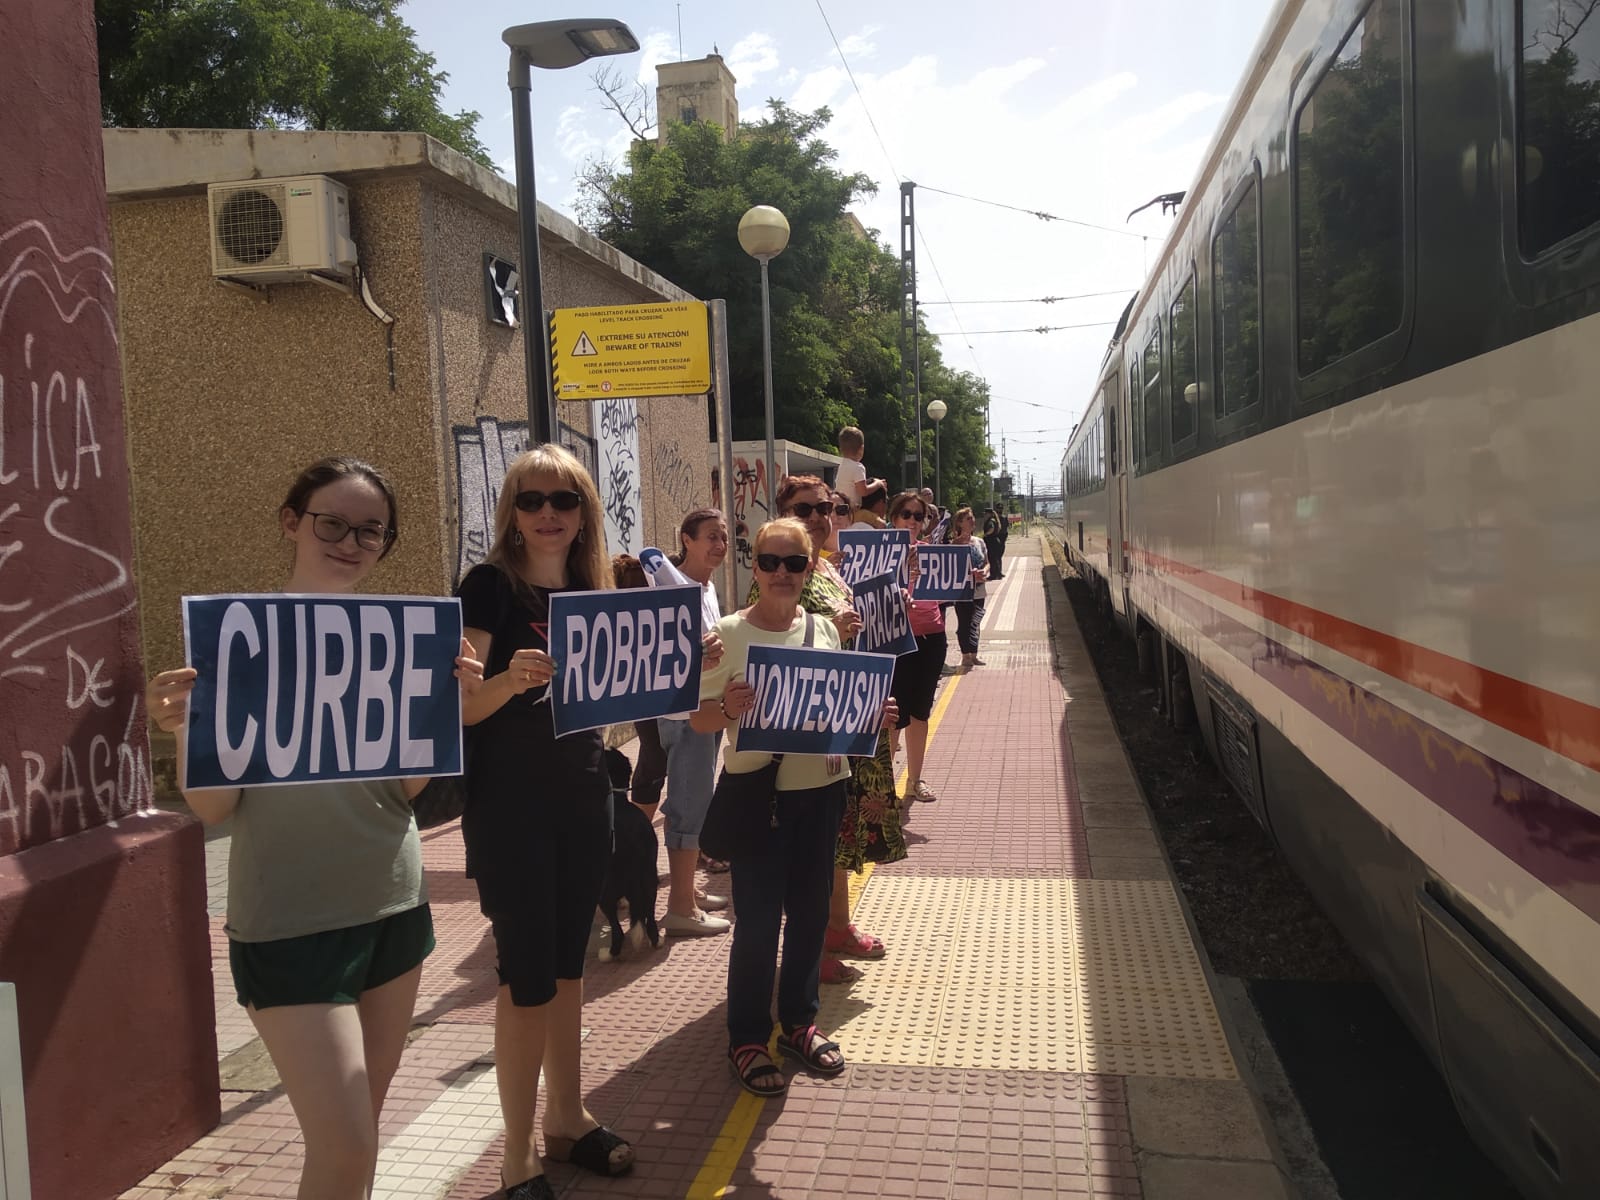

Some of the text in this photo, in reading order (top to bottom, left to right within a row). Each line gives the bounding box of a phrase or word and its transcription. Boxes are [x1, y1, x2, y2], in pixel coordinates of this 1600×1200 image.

[605, 341, 682, 352] BEWARE OF TRAINS!
[635, 332, 646, 340] SU
[648, 330, 689, 339] ATENCIÓN!
[915, 552, 975, 591] FRULA
[854, 582, 908, 652] PIRACES
[562, 604, 693, 705] ROBRES
[214, 600, 437, 782] CURBE
[740, 663, 889, 735] MONTESUSIN
